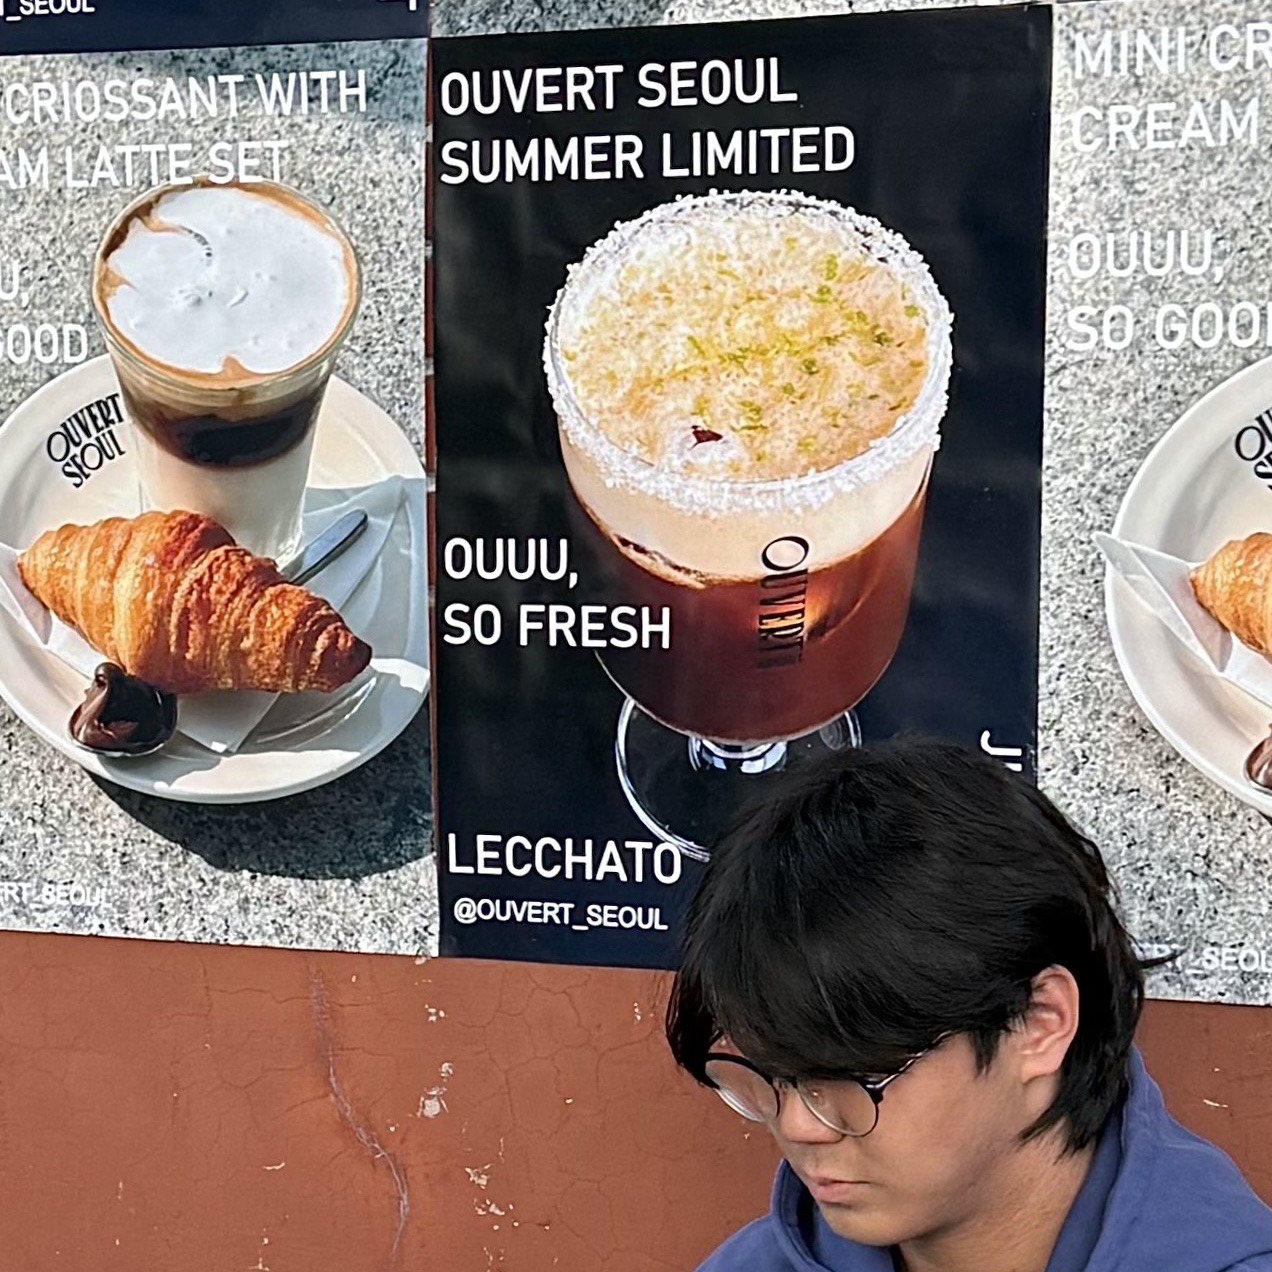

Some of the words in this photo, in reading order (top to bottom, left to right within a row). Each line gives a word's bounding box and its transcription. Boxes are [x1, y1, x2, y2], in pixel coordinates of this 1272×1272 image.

[1074, 27, 1186, 79] MINI
[5, 74, 244, 124] CRIOSSANT
[255, 69, 367, 116] WITH
[442, 65, 623, 115] OUVERT
[639, 58, 797, 107] SEOUL
[1071, 98, 1259, 152] CREAM
[66, 143, 193, 188] LATTE
[208, 140, 289, 184] SET
[441, 135, 643, 183] SUMMER
[663, 127, 854, 176] LIMITED
[1069, 230, 1223, 283] OUUU,
[1068, 304, 1133, 350] SO
[47, 392, 124, 462] OUVERT
[61, 429, 126, 489] SEOUL
[445, 538, 577, 588] OUUU,
[444, 604, 500, 644] SO
[520, 605, 669, 648] FRESH
[758, 536, 809, 668] OUVERT
[448, 833, 682, 884] LECCHATO
[454, 898, 667, 930] @OUVERT_SEOUL
